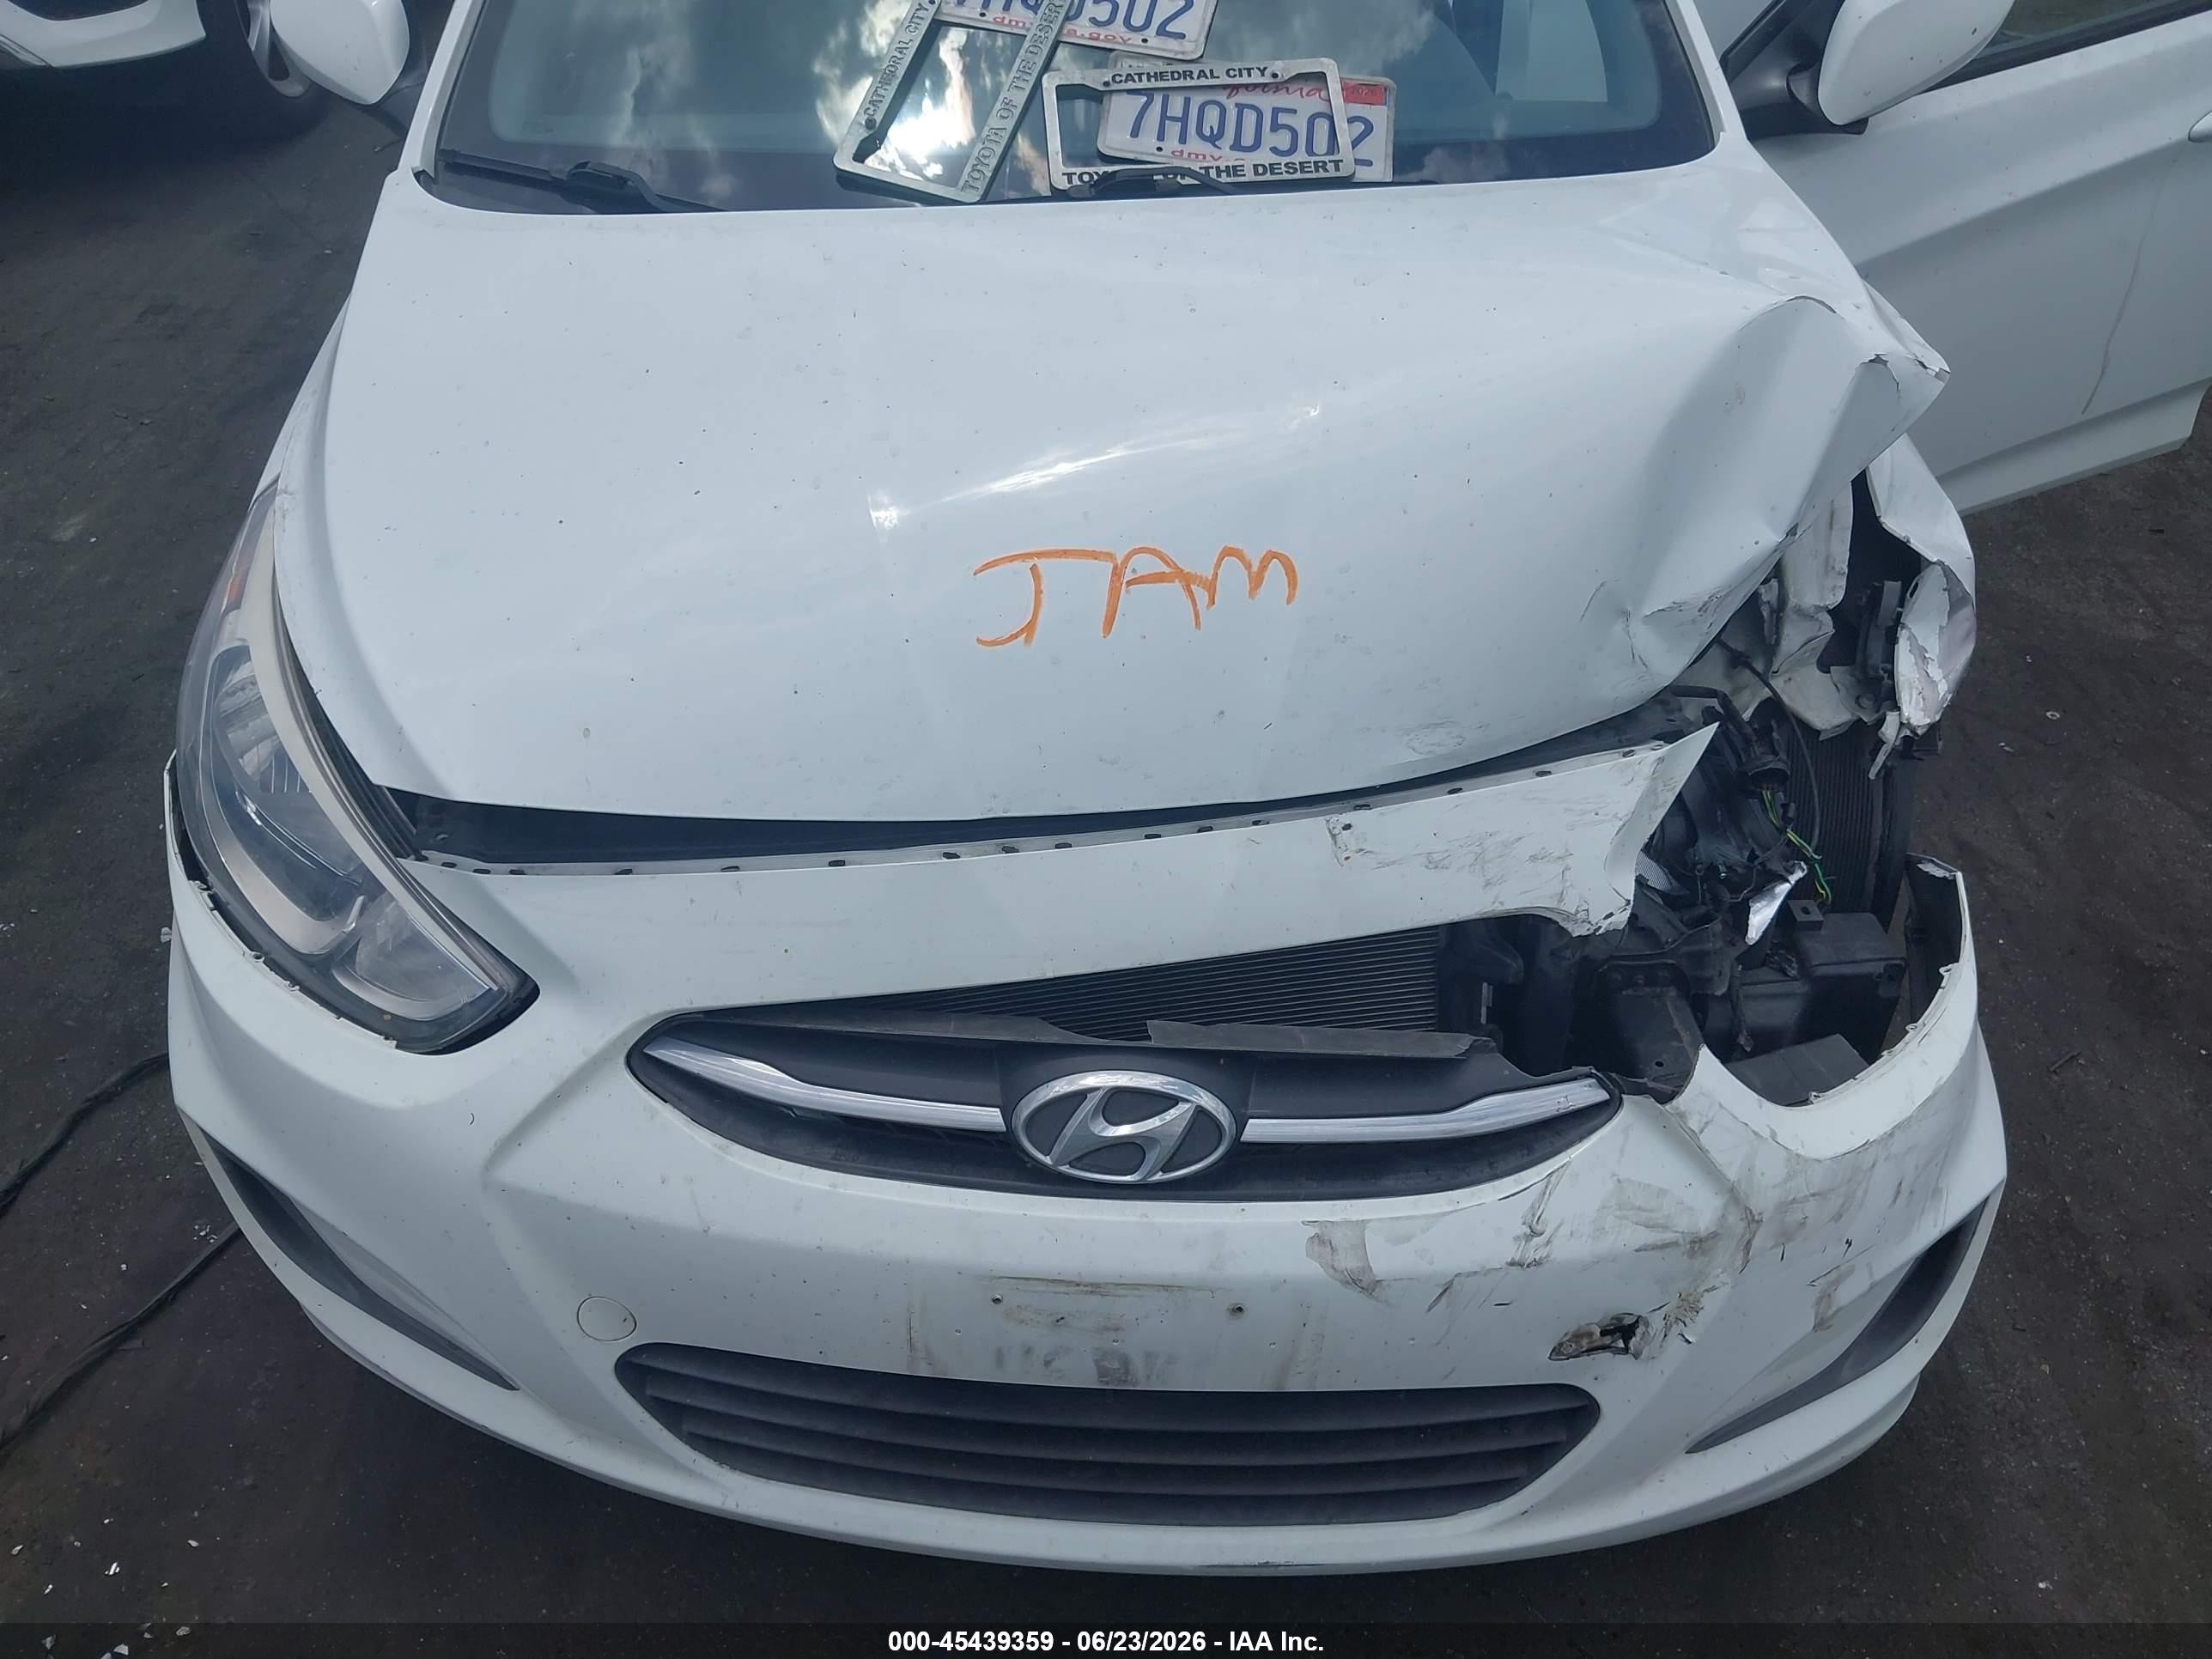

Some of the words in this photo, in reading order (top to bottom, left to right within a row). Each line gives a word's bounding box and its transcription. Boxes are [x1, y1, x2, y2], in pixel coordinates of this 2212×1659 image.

[1024, 0, 1066, 56] DESER
[863, 38, 914, 118] CATHEDRAL
[905, 3, 930, 38] CITY
[1007, 58, 1037, 93] THE
[1111, 69, 1220, 84] CATHEDRAL
[1225, 66, 1269, 79] CITY
[996, 96, 1020, 122] OF
[1126, 91, 1374, 167] 7HQD502
[961, 126, 1007, 194] TOYOTA
[1200, 164, 1247, 179] THE
[1252, 159, 1344, 177] DESERT
